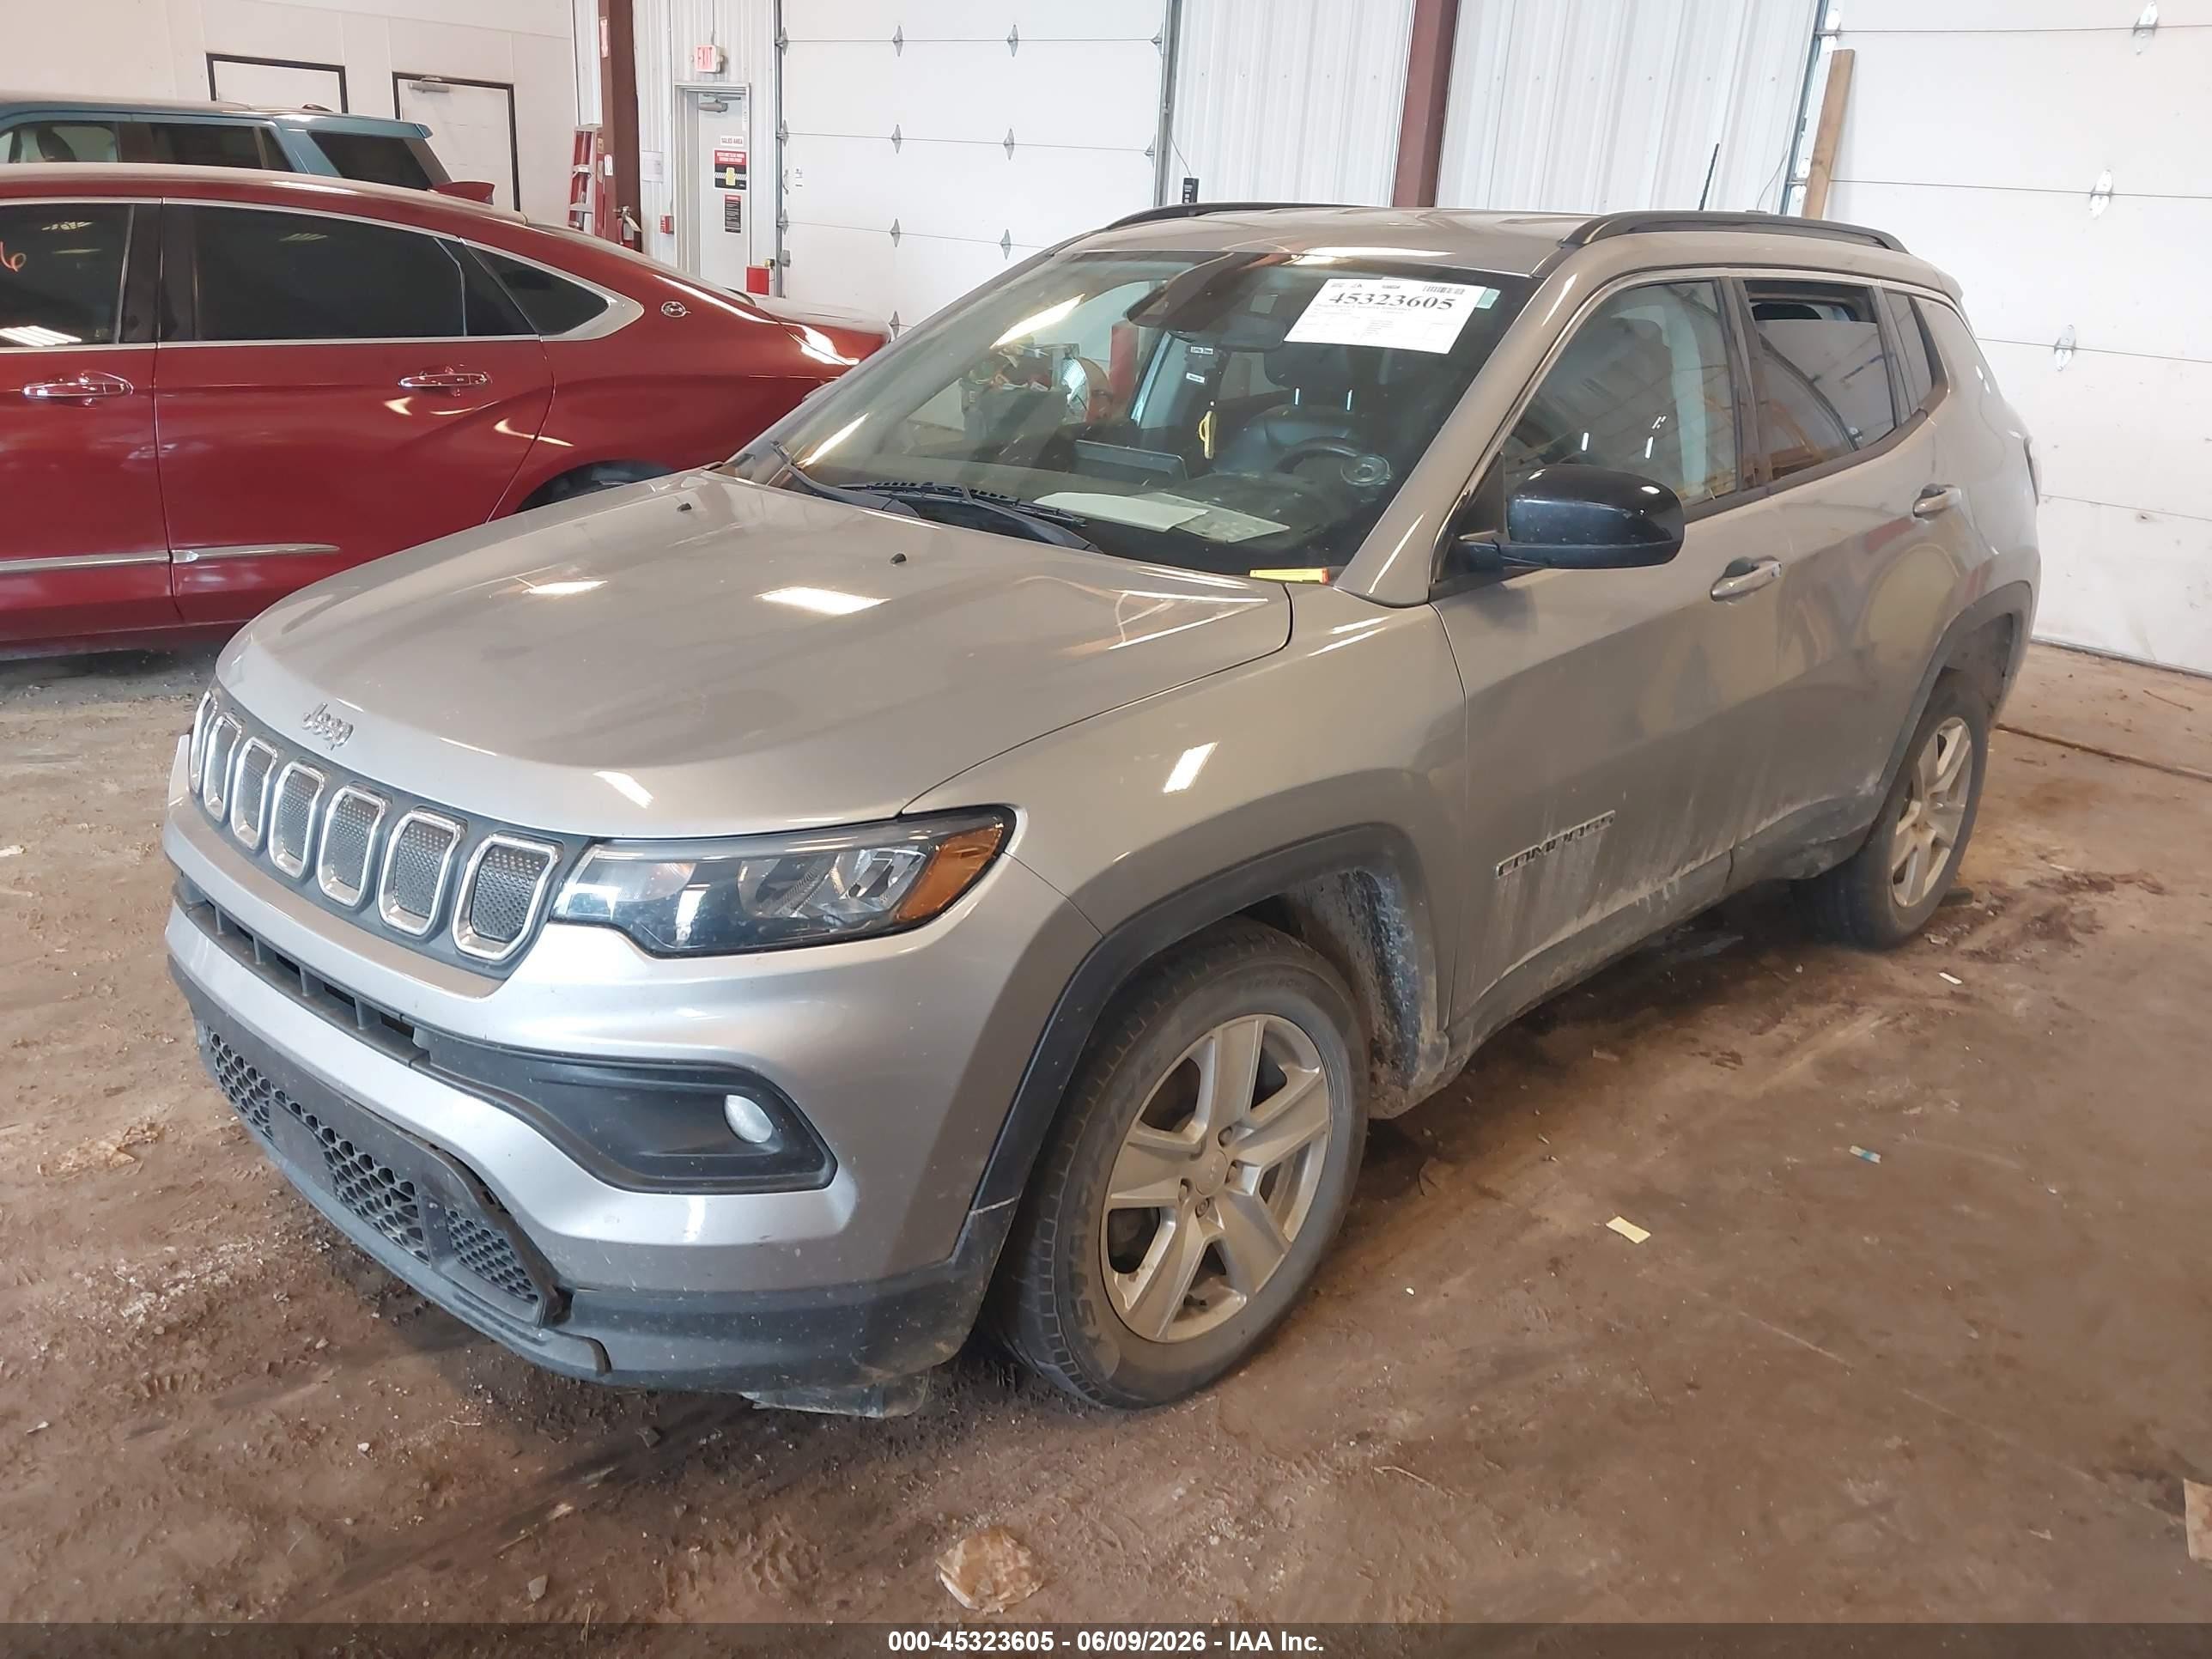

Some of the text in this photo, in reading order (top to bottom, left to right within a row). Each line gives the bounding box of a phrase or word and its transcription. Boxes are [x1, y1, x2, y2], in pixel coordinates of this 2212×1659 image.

[696, 46, 714, 70] EXIT
[1328, 292, 1456, 310] 45323605
[301, 702, 354, 750] Jeep
